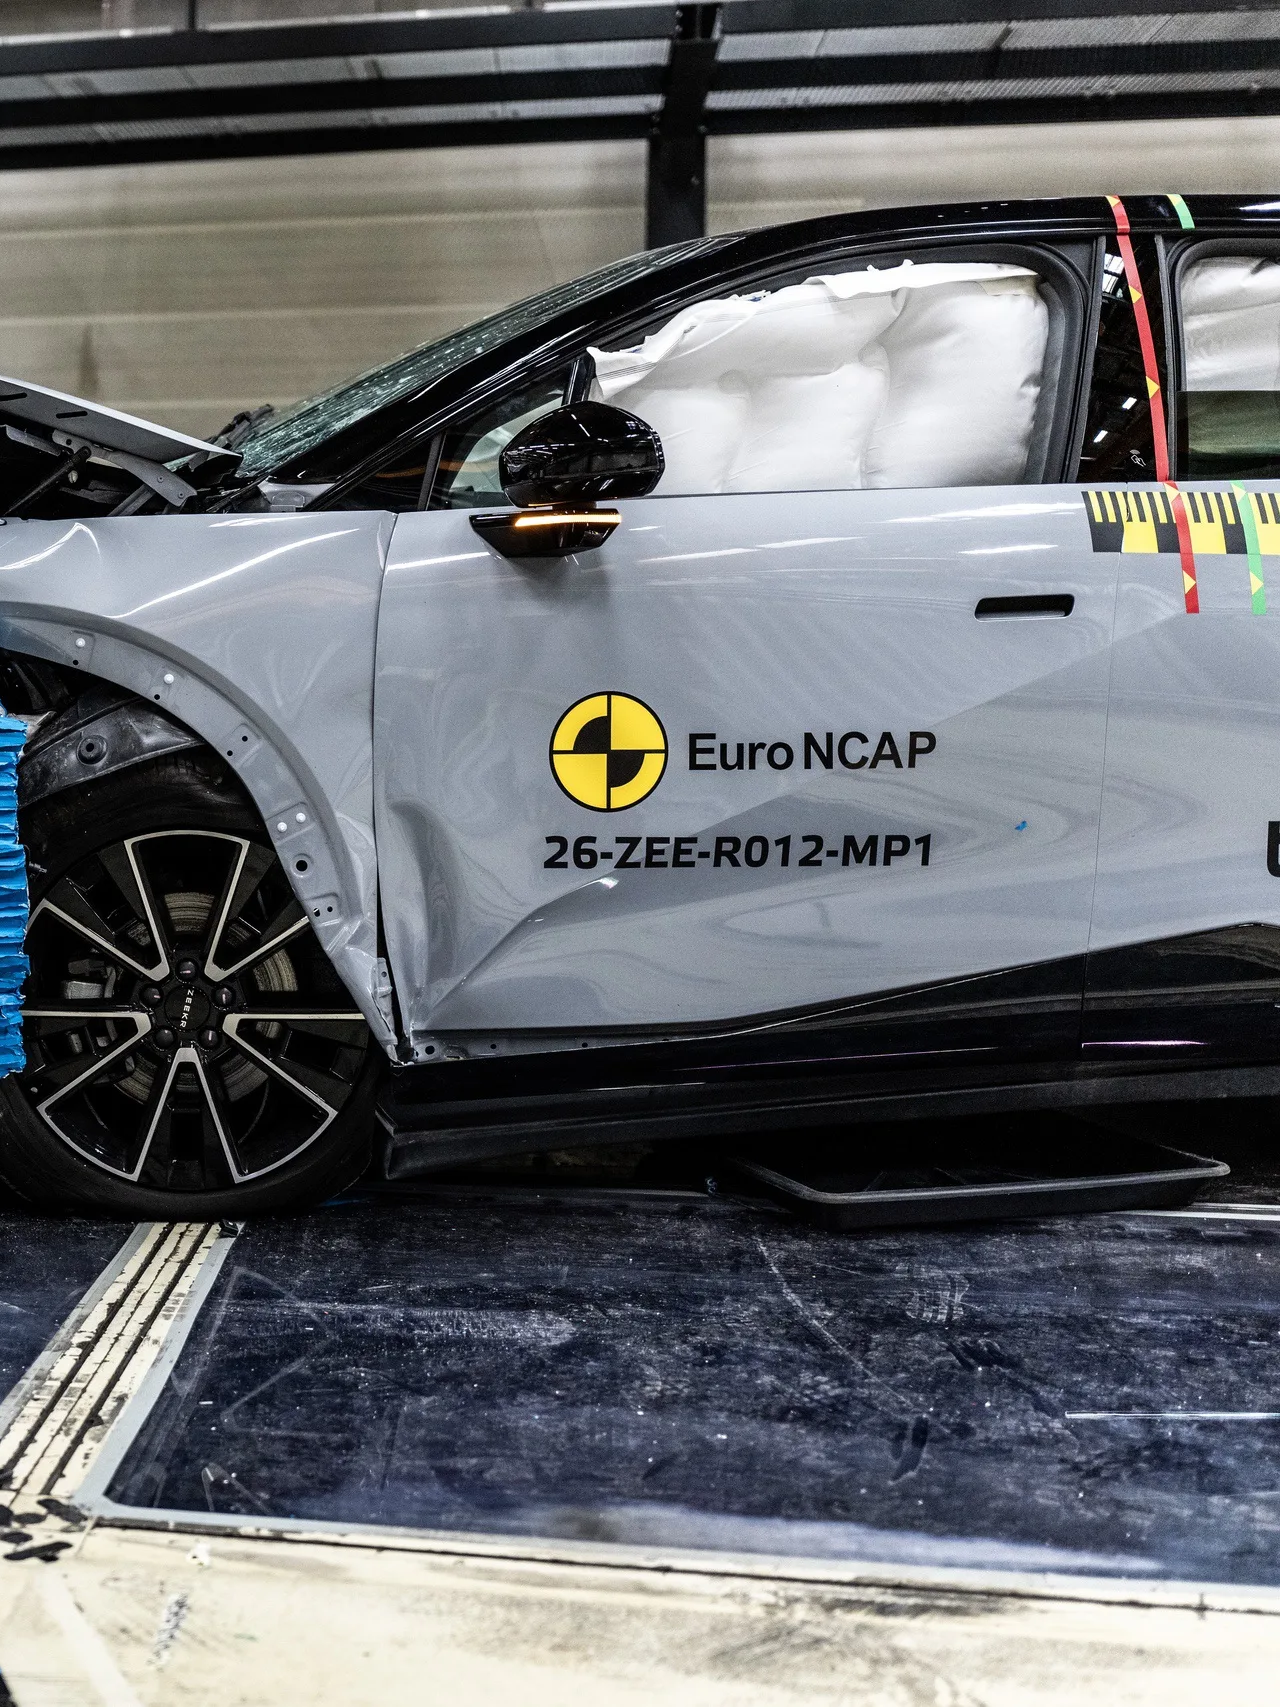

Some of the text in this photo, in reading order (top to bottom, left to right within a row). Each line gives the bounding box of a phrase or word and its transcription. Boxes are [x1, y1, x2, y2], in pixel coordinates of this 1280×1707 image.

[688, 730, 937, 771] Euro NCAP
[542, 833, 932, 870] 26-ZEE-R012-MP1
[180, 989, 195, 1028] ZEEKR
